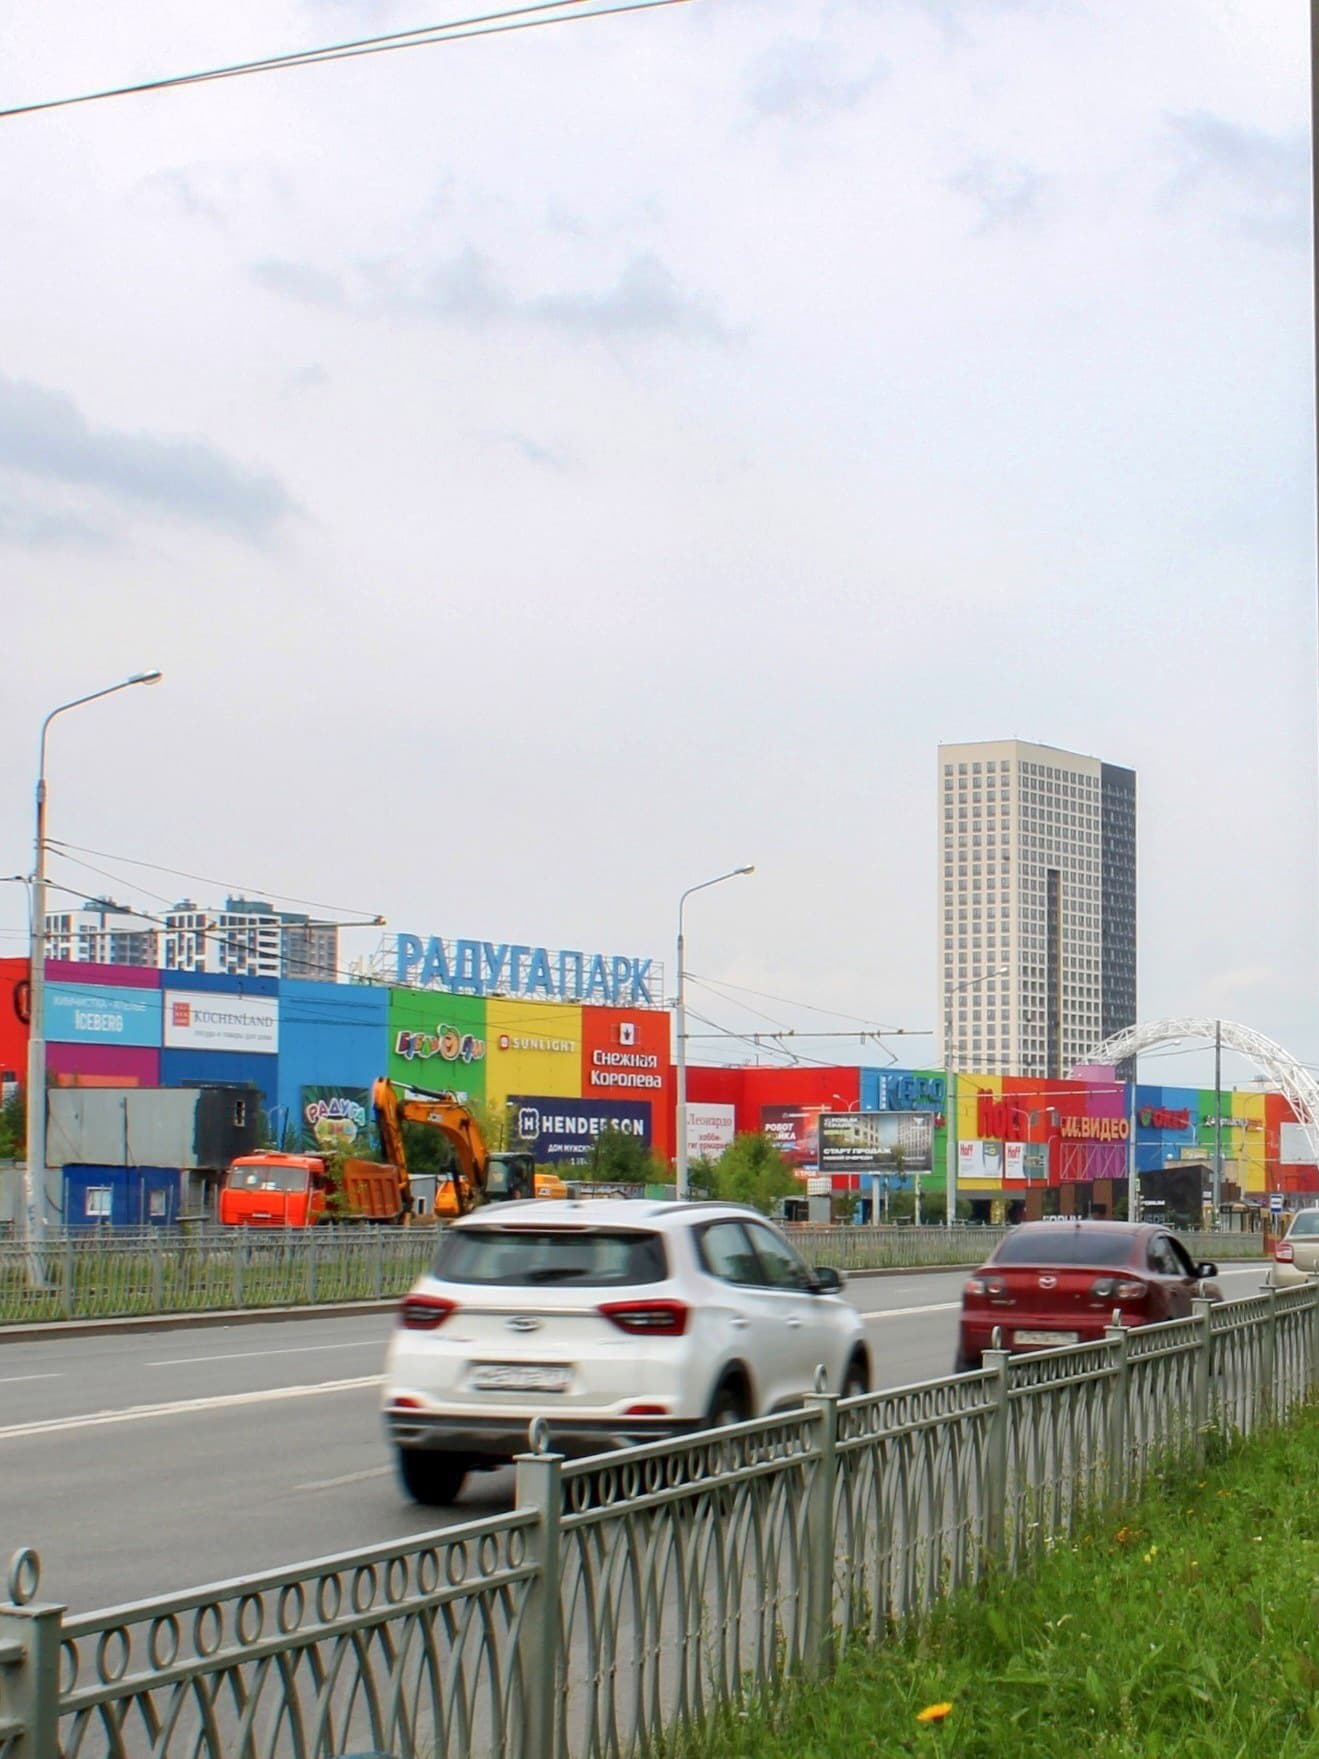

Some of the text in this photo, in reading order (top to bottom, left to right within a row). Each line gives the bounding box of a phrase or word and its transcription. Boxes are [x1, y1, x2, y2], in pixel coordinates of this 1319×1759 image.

[397, 933, 653, 1004] РАДУГАПАРК
[75, 1009, 123, 1032] ICEBERG
[512, 1037, 576, 1052] SUNLIGHT
[594, 1050, 657, 1067] Снежная
[591, 1070, 662, 1088] Королева
[688, 1113, 732, 1128] Леонардо
[765, 1123, 794, 1131] РОБОТ
